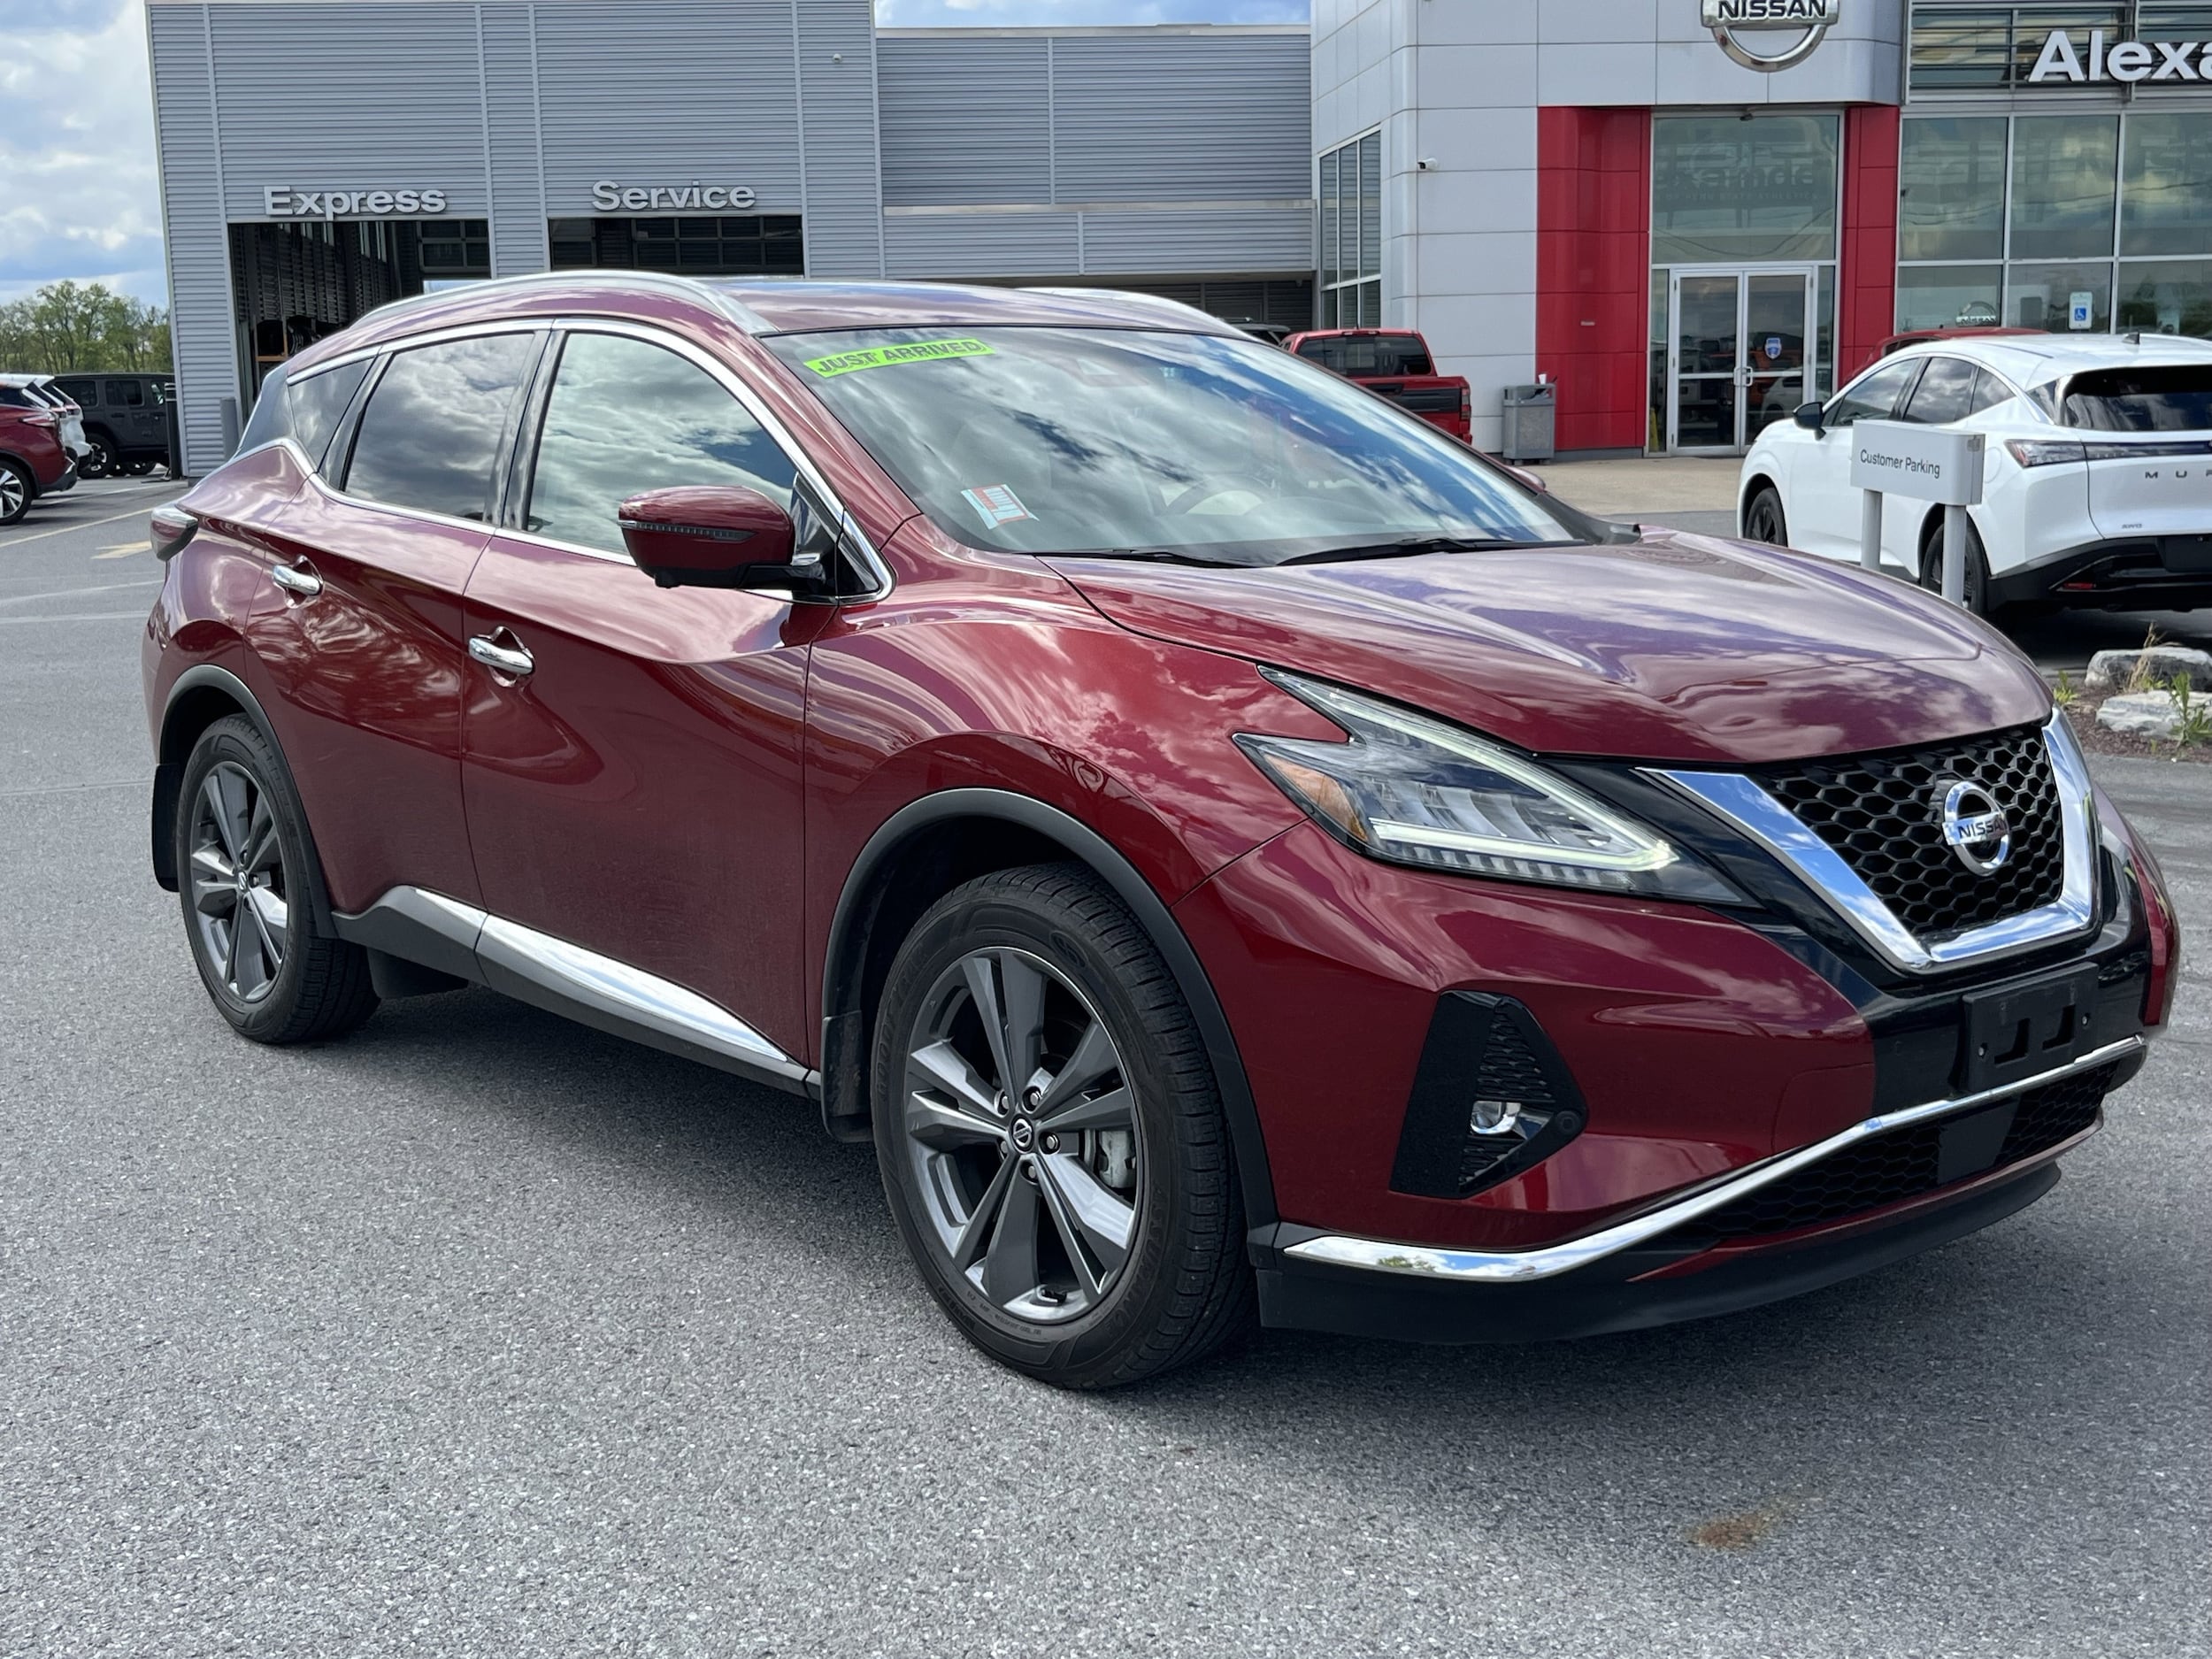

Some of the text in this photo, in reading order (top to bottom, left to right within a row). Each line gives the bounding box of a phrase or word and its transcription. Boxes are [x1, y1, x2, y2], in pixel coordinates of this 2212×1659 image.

[1718, 0, 1827, 19] NISSAN
[265, 185, 447, 220] Express
[592, 180, 756, 211] Service
[818, 340, 983, 373] JUST ARRIVED
[1860, 449, 1940, 479] Customer Parking
[1958, 818, 2007, 839] NISSAN
